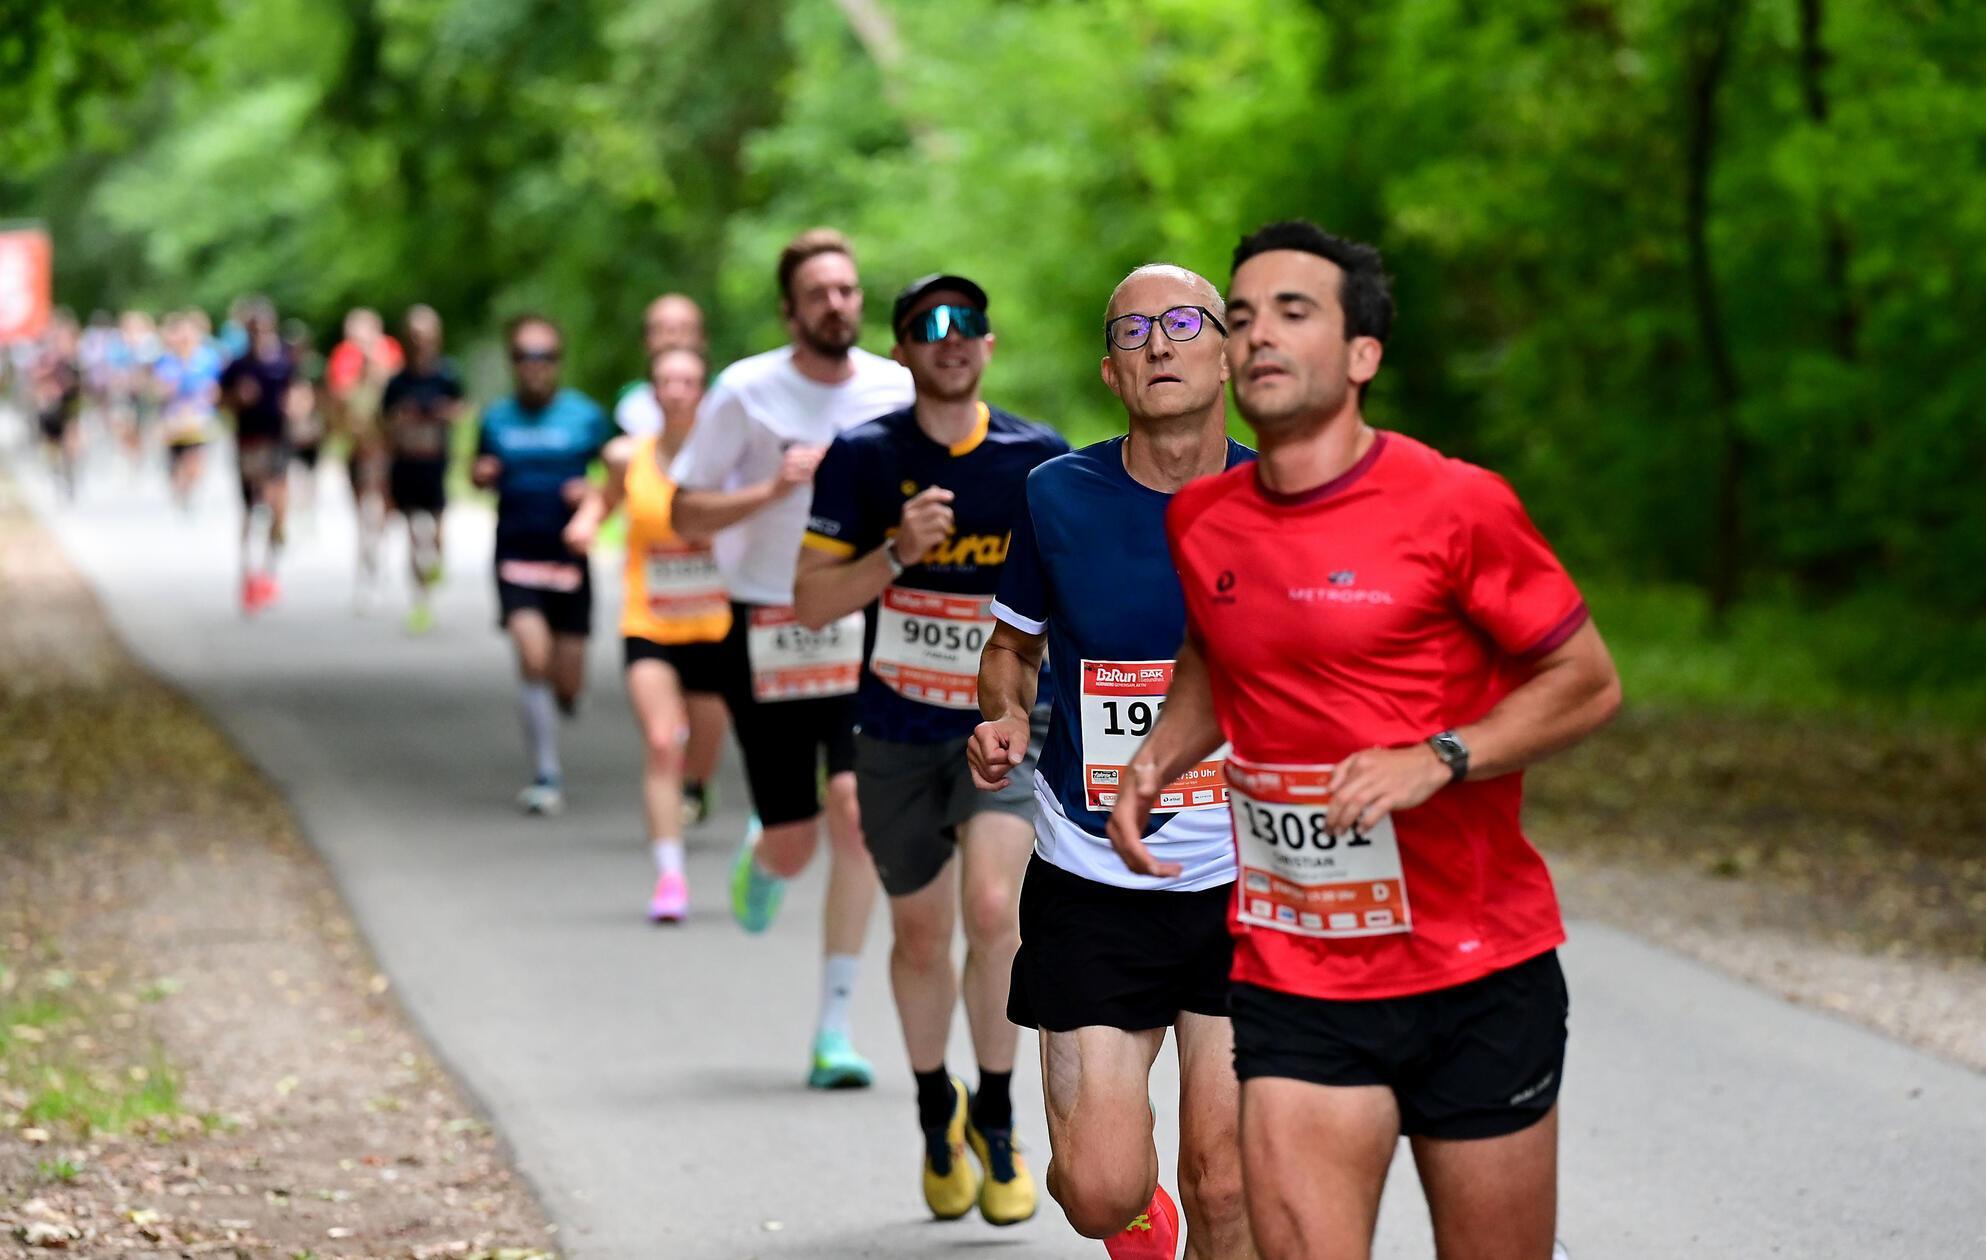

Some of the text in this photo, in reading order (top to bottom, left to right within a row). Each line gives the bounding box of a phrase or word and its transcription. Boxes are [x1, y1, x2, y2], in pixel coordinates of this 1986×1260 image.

[1288, 587, 1394, 605] METROPOL
[902, 619, 983, 652] 9050
[1096, 668, 1137, 682] B2Run
[1140, 669, 1164, 678] DAK
[1200, 769, 1216, 778] Uhr
